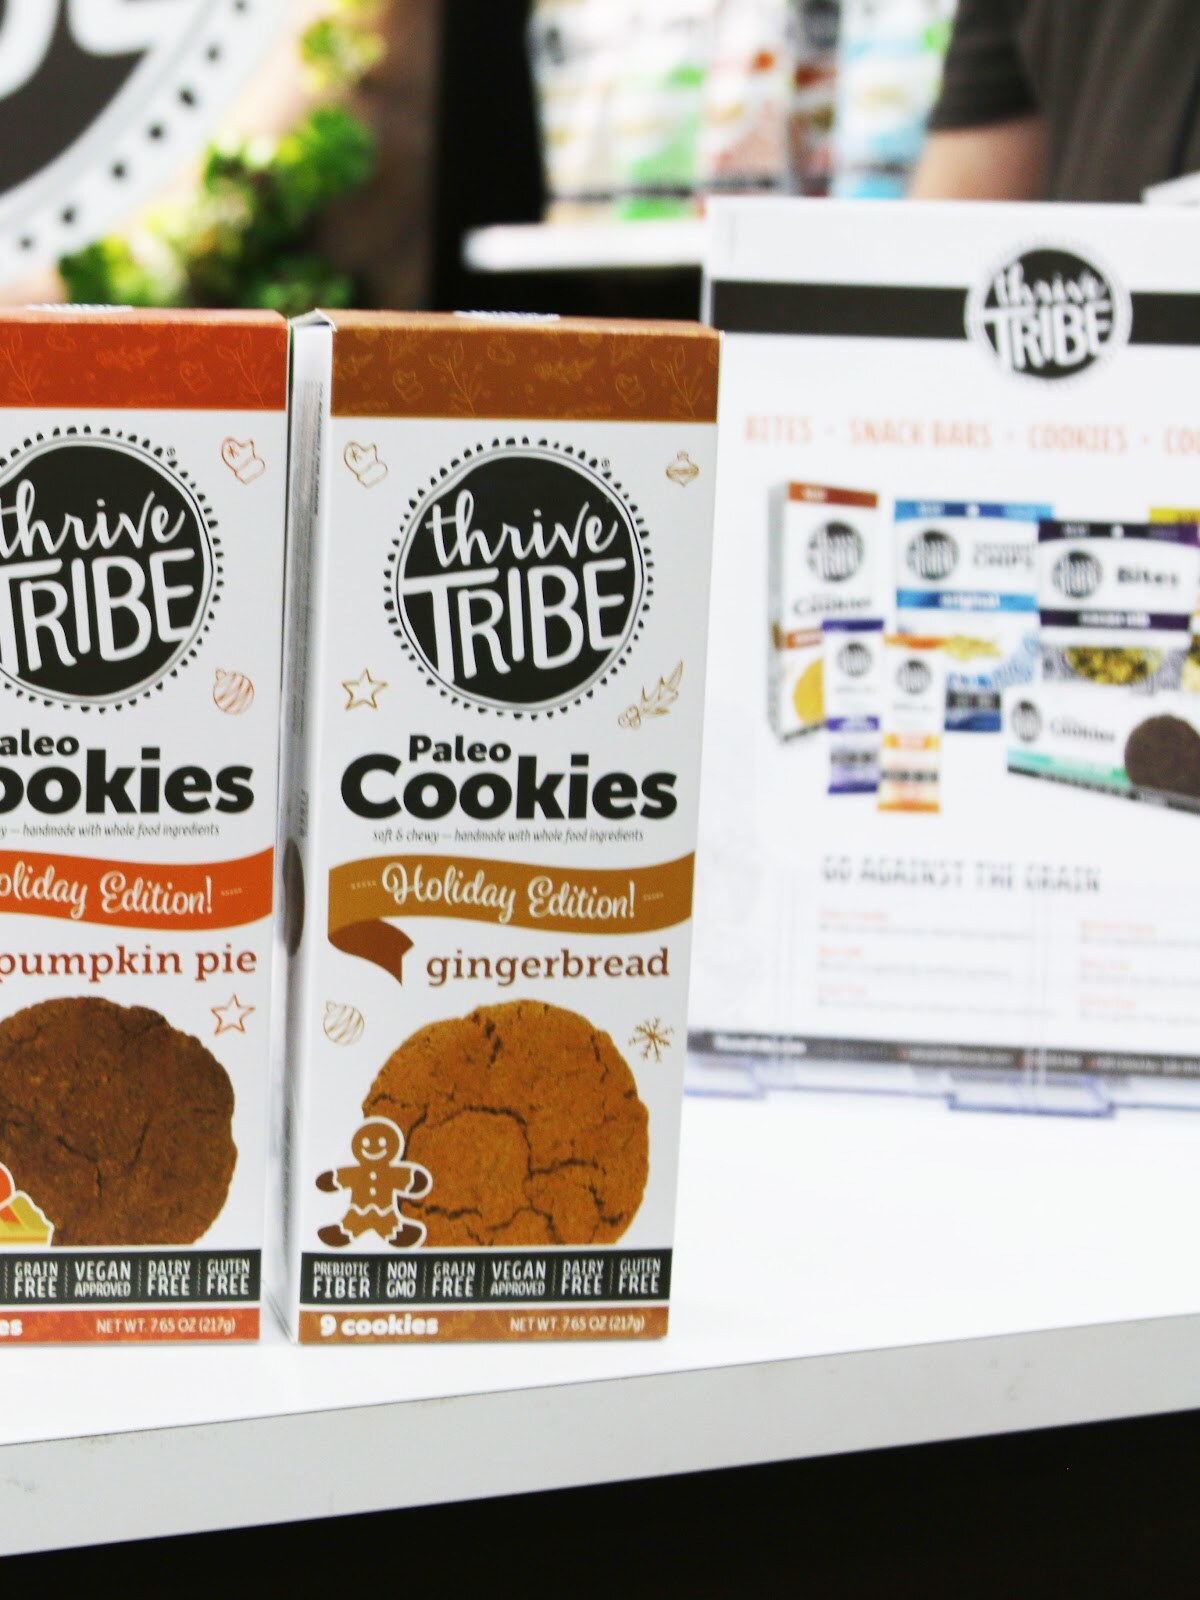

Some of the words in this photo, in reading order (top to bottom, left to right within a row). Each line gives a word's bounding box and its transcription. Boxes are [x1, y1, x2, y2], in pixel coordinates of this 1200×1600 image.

[982, 299, 1112, 371] TRIBE
[745, 415, 812, 444] BITES
[849, 416, 923, 447] SNACK
[932, 420, 992, 449] BARS
[1028, 422, 1128, 454] COOKIES
[425, 489, 618, 567] thrive
[402, 558, 627, 682] TRIBE
[409, 734, 512, 763] Paleo
[340, 753, 678, 820] Cookies
[100, 871, 213, 916] Edition!
[381, 862, 516, 925] Holiday
[527, 876, 636, 920] Edition!
[195, 943, 257, 982] pie
[425, 947, 670, 987] gingerbread
[14, 1261, 58, 1278] GRAIN
[74, 1260, 131, 1280] VEGAN
[148, 1260, 191, 1276] DAIRY
[207, 1258, 251, 1275] GLUTEN
[313, 1262, 369, 1276] PREBIOTIC
[387, 1261, 418, 1280] NON
[434, 1261, 476, 1277] GRAIN
[492, 1260, 547, 1280] VEGAN
[563, 1260, 604, 1276] DAIRY
[620, 1258, 661, 1275] GLUTEN
[14, 1277, 57, 1298] FREE
[74, 1281, 131, 1298] APPROVED
[148, 1275, 190, 1296] FREE
[207, 1274, 250, 1295] FREE
[313, 1277, 371, 1298] FIBER
[386, 1280, 416, 1298] GMO
[432, 1276, 474, 1297] FREE
[490, 1280, 546, 1296] APPROVED
[561, 1275, 603, 1296] FREE
[618, 1274, 659, 1295] FREE
[96, 1318, 122, 1334] NET
[178, 1316, 197, 1333] OZ
[319, 1315, 337, 1337] 9
[341, 1314, 439, 1335] cookies
[510, 1317, 533, 1333] NET
[589, 1315, 607, 1332] OZ
